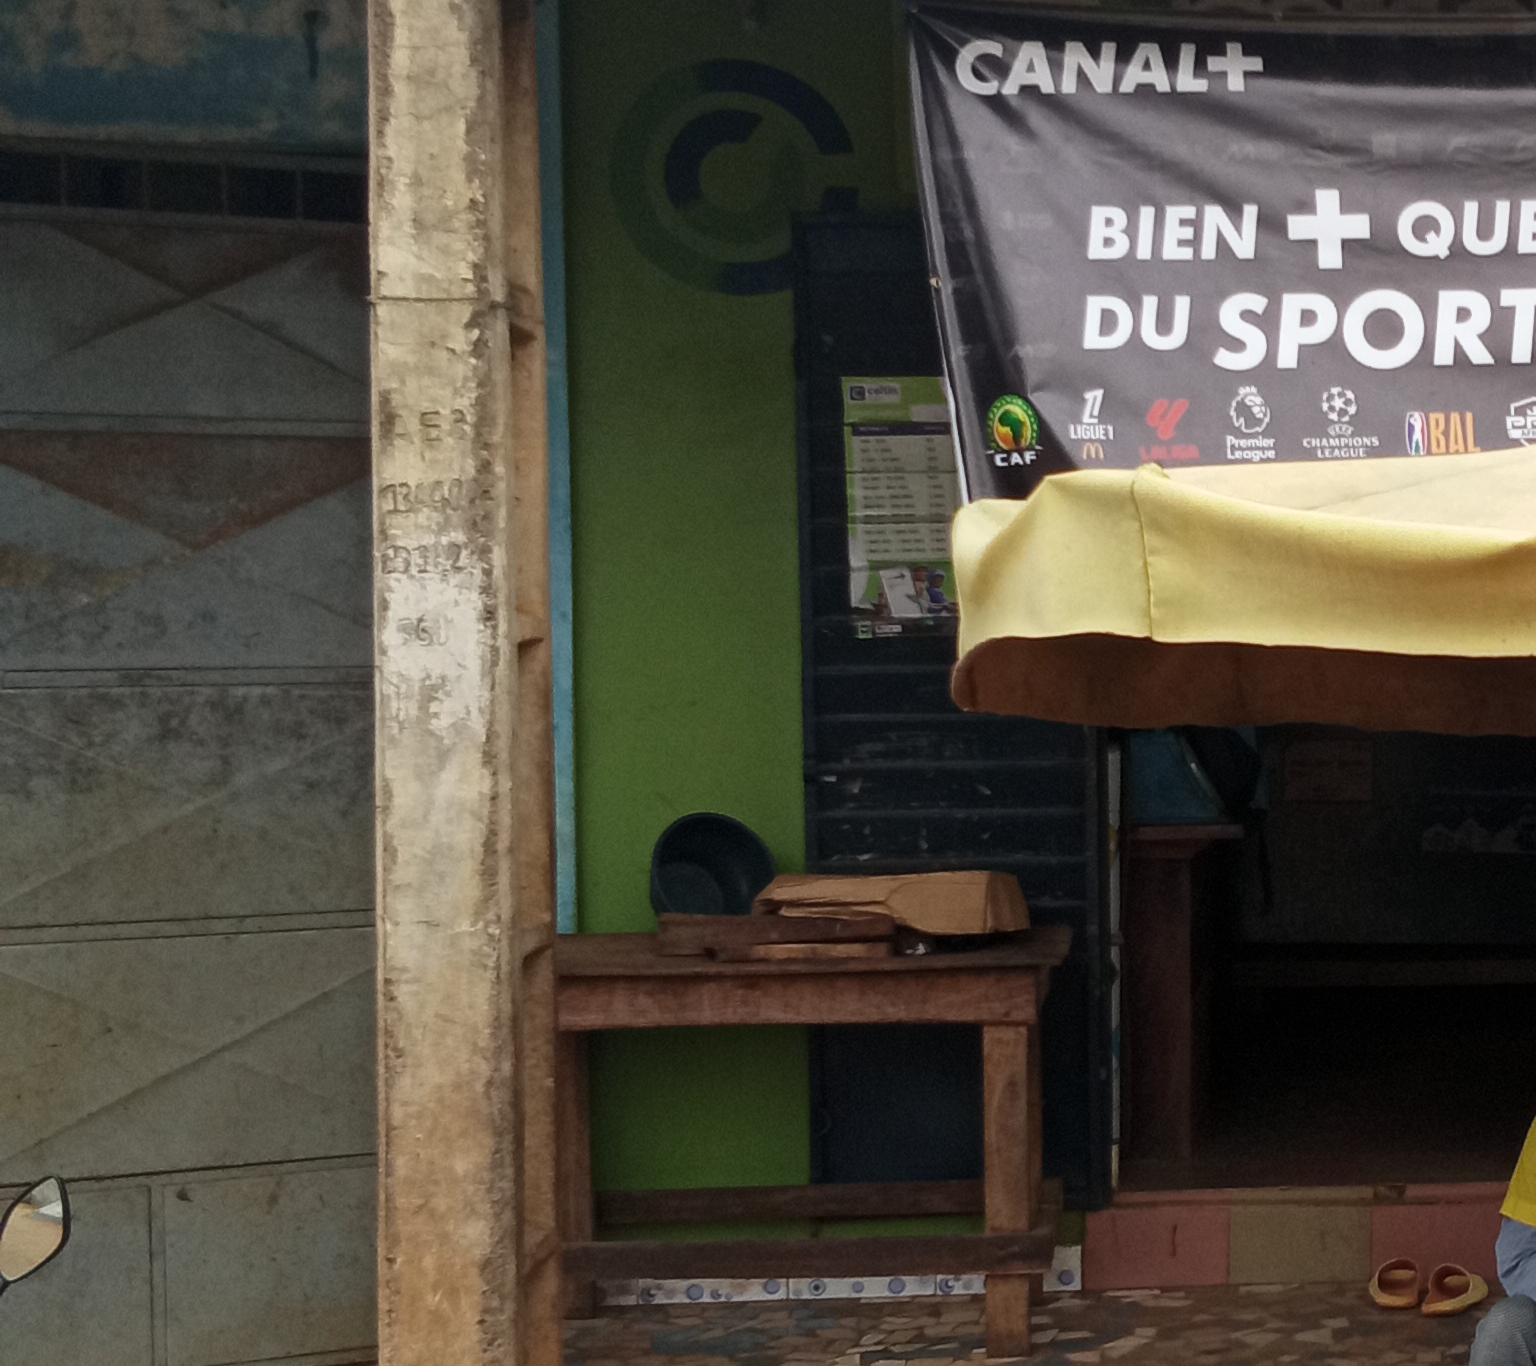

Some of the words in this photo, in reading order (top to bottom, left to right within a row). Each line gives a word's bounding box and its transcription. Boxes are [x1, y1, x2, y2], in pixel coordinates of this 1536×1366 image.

[955, 39, 1264, 95] CANAL+
[1087, 204, 1259, 261] BIEN
[1082, 294, 1191, 351] DU
[1429, 411, 1481, 454] BAL
[1226, 436, 1276, 450] Premier
[1302, 436, 1380, 449] CHAMPIONS
[994, 452, 1038, 467] CAF
[1226, 447, 1276, 462] League
[1316, 447, 1367, 459] LEAGUE
